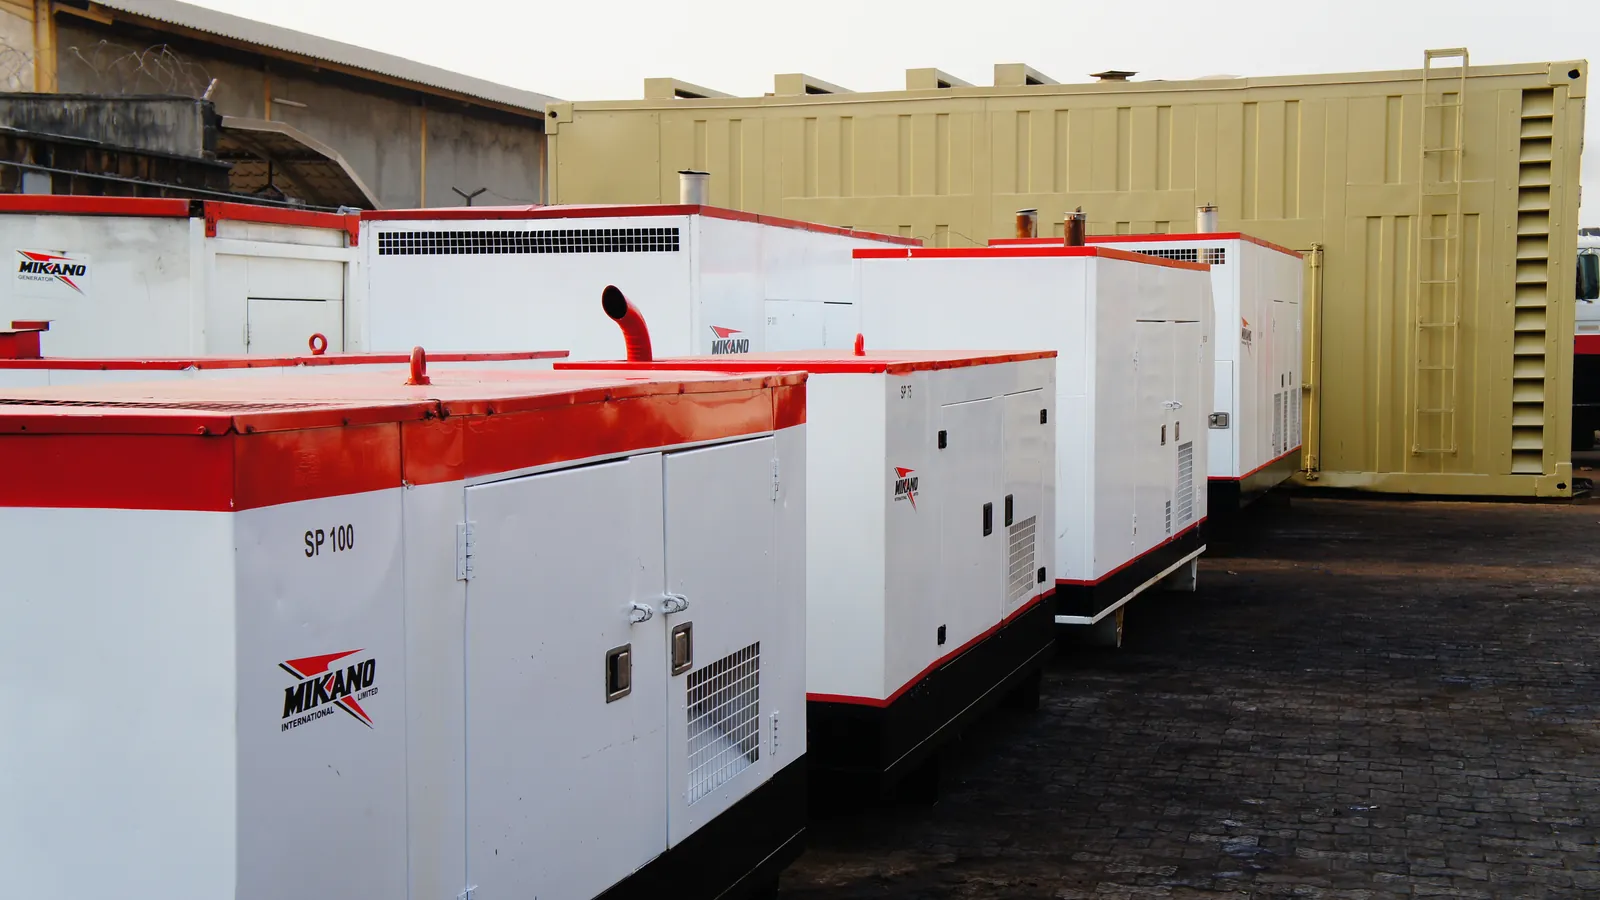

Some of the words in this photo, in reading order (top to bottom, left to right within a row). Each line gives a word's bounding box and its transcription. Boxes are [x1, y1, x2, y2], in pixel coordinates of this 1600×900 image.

[18, 261, 87, 276] MIKANO
[18, 274, 54, 282] GENERATOR
[712, 339, 749, 355] MIKANO
[901, 385, 906, 399] SP
[895, 476, 919, 496] MIKANO
[304, 528, 325, 558] SP
[329, 523, 354, 553] 100
[282, 658, 376, 719] MIKANO
[281, 706, 334, 732] INTERNATIONAL
[357, 687, 378, 701] LIMITED
